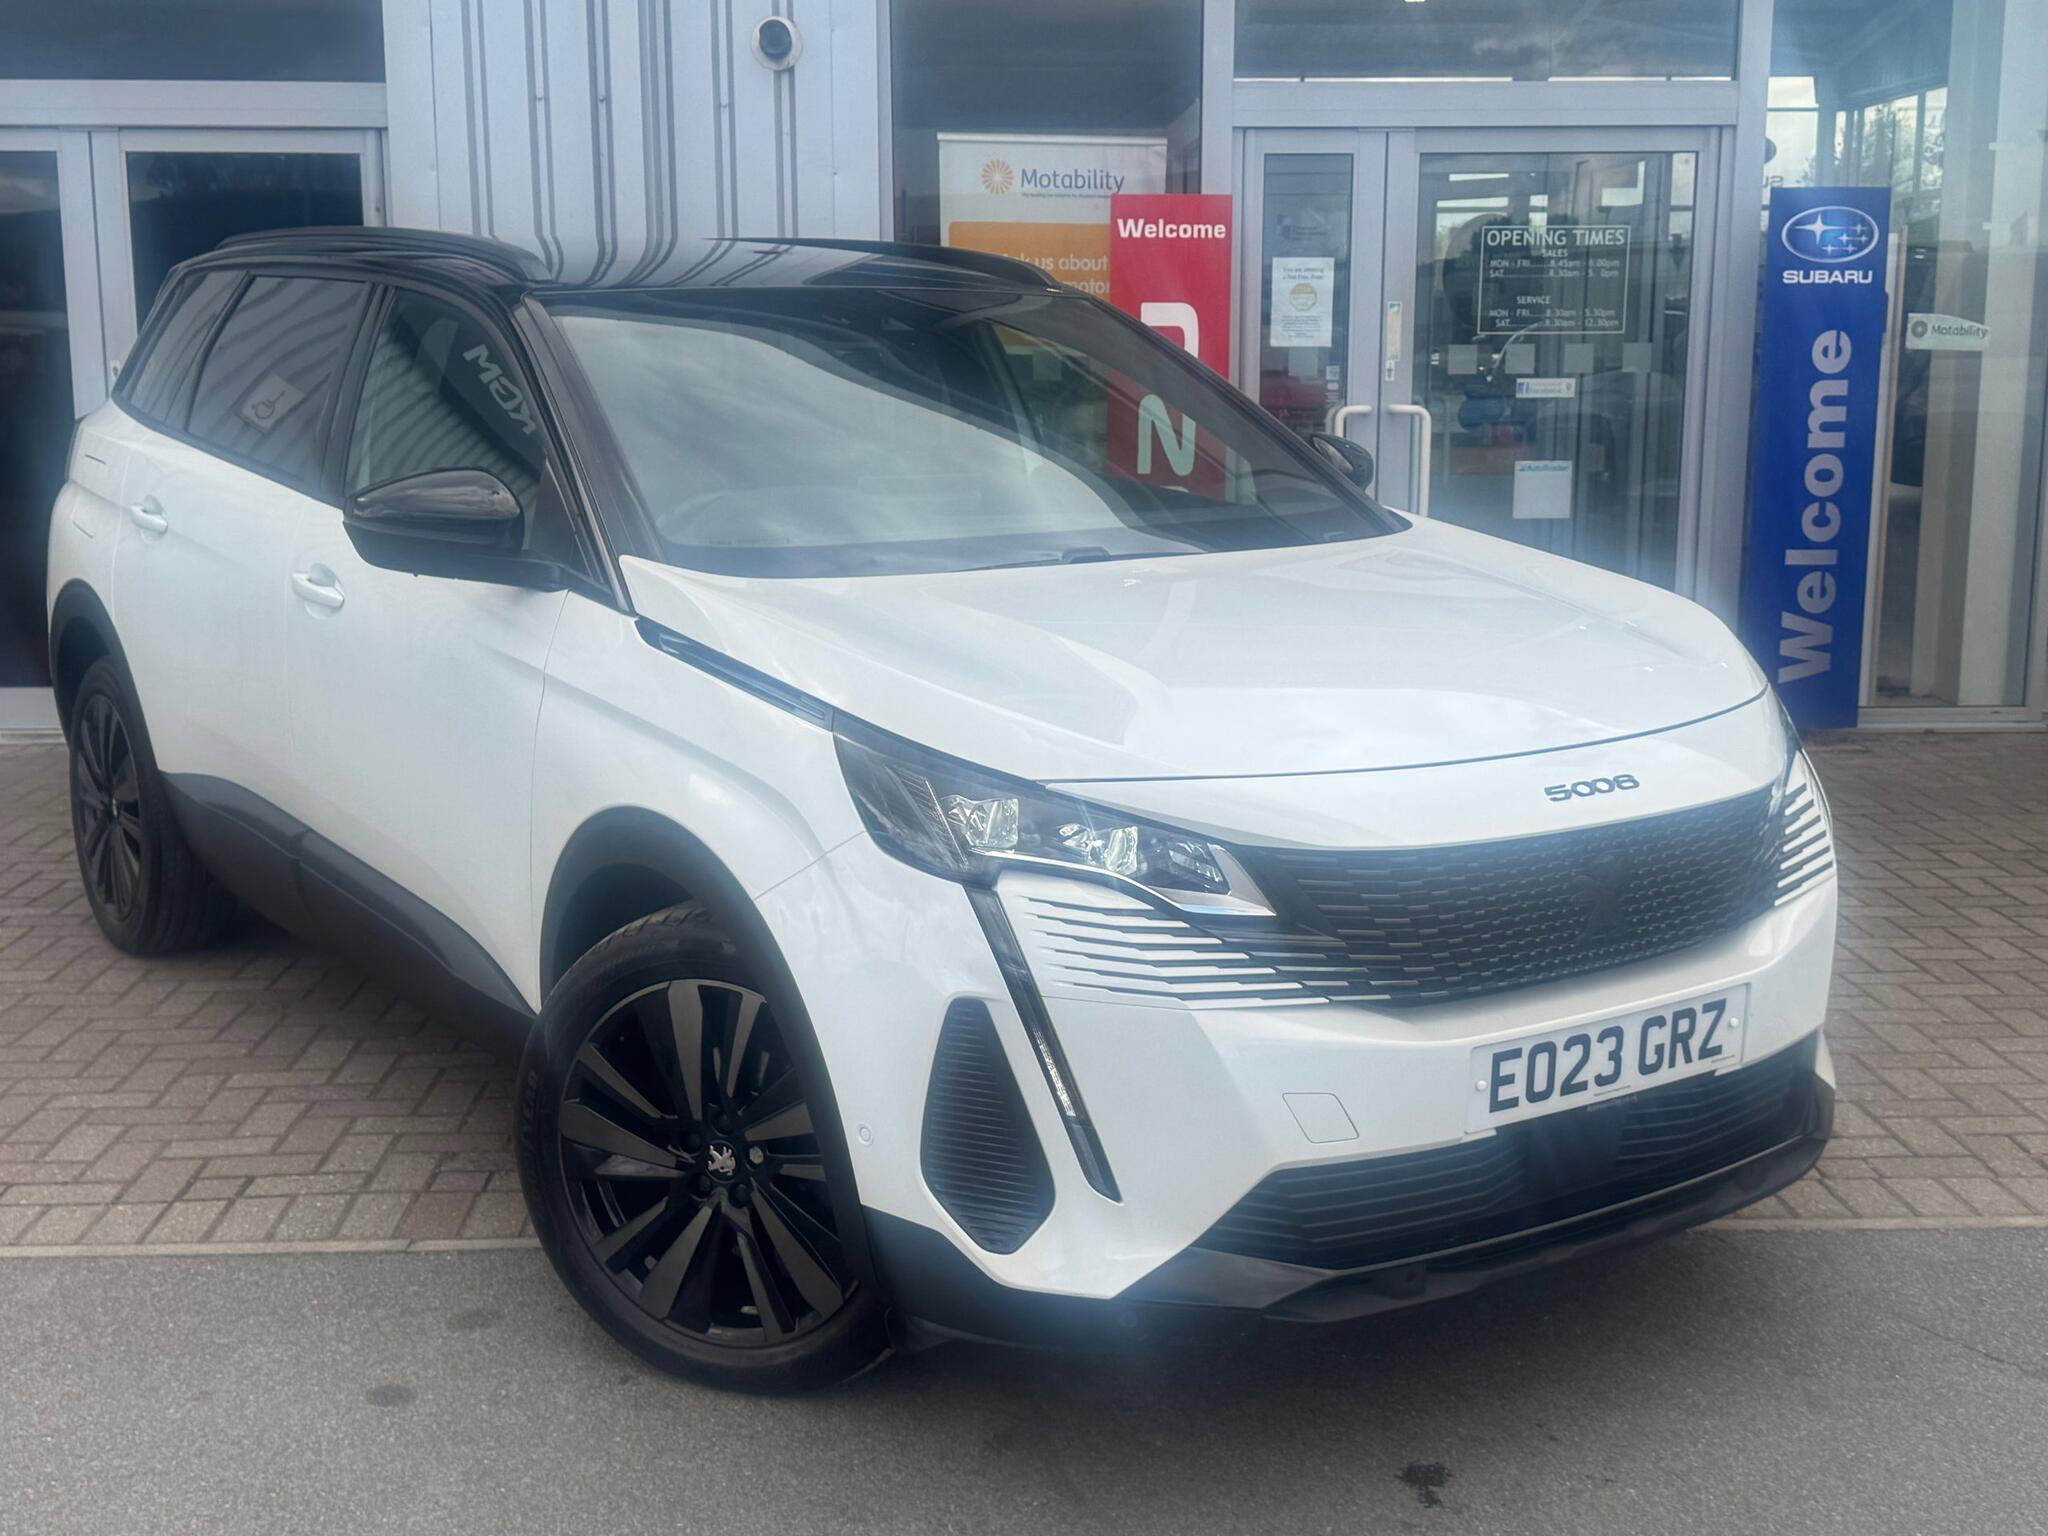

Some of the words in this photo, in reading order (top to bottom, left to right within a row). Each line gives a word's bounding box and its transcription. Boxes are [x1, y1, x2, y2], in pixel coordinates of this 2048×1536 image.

[1020, 168, 1125, 194] Motability
[1117, 217, 1226, 239] Welcome
[1487, 229, 1567, 246] OPENING
[1572, 229, 1625, 245] TIMES
[1541, 248, 1568, 257] SALES
[1035, 256, 1054, 270] us
[1058, 253, 1109, 270] about
[1490, 260, 1508, 268] MON
[1490, 269, 1505, 277] SAT
[1783, 270, 1873, 284] SUBARU
[1516, 296, 1551, 304] SERVICE
[1489, 309, 1508, 317] MON
[1495, 318, 1511, 327] SAT
[1931, 325, 1988, 338] Motability
[1777, 329, 1852, 684] Welcome
[1544, 774, 1640, 801] 5008
[1638, 998, 1727, 1076] GRZ
